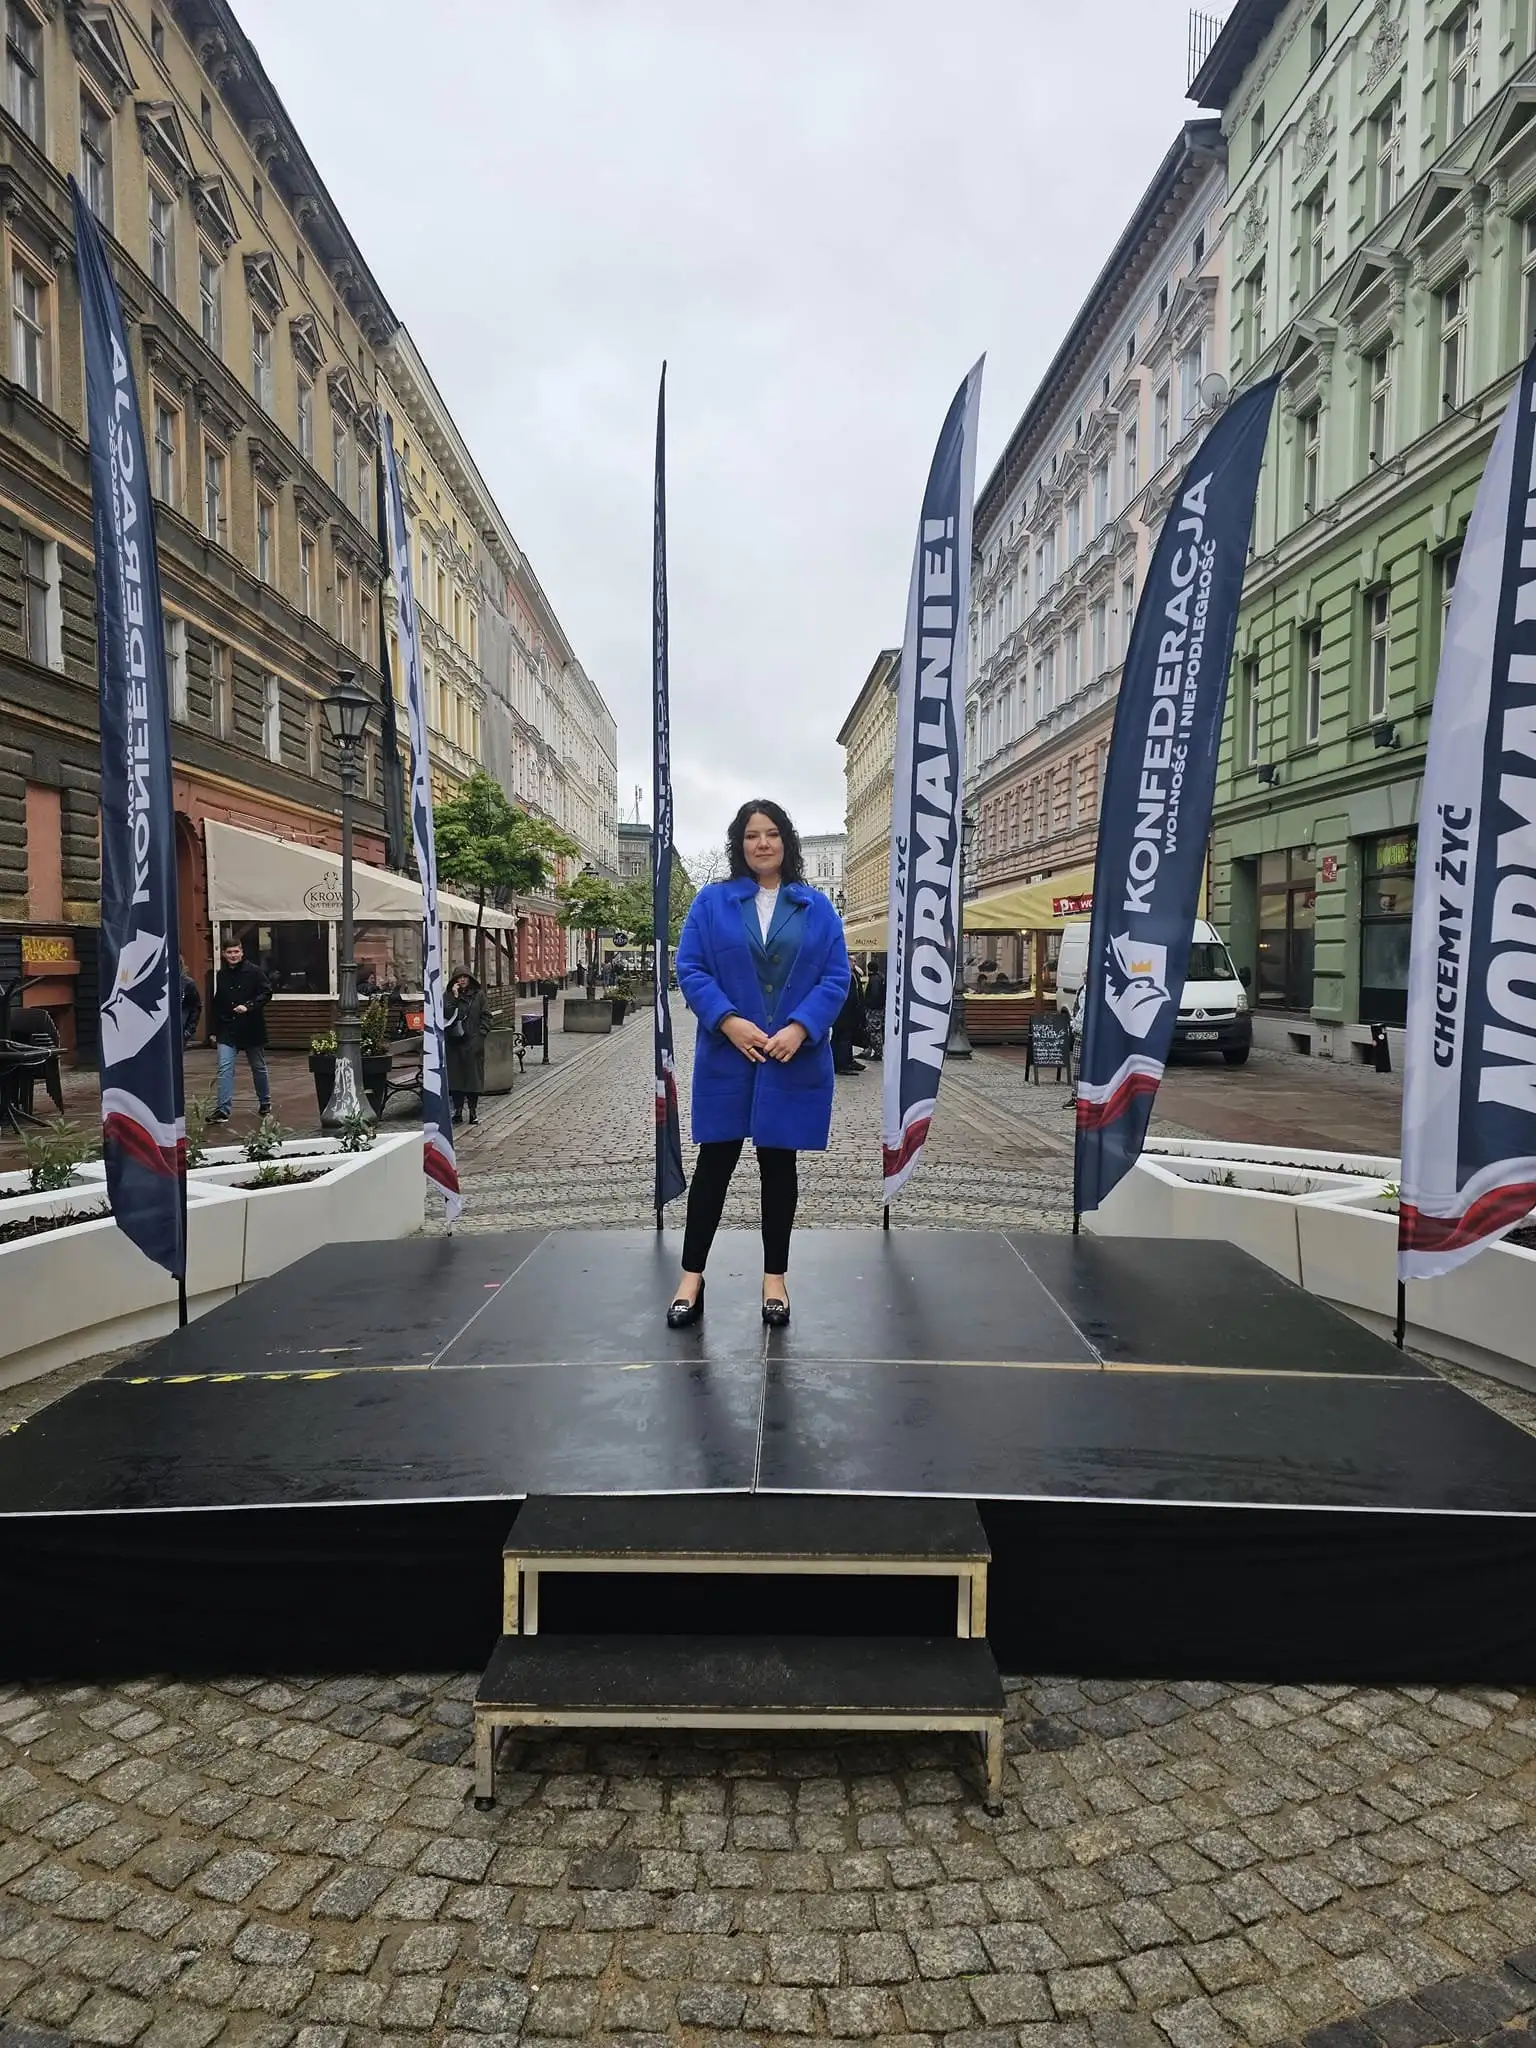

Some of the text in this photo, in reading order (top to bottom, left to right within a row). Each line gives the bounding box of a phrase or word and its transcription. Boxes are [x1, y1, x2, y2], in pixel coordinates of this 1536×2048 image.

[907, 516, 954, 1070] NORMALNIE!
[1123, 471, 1214, 913] KONFEDERACJA
[1164, 744, 1188, 855] WOLNOŚĆ
[1180, 538, 1217, 728] NIEPODLEGŁOŚĆ
[310, 891, 343, 901] KROW
[1434, 804, 1472, 1067] CHCEMY ŻYĆ
